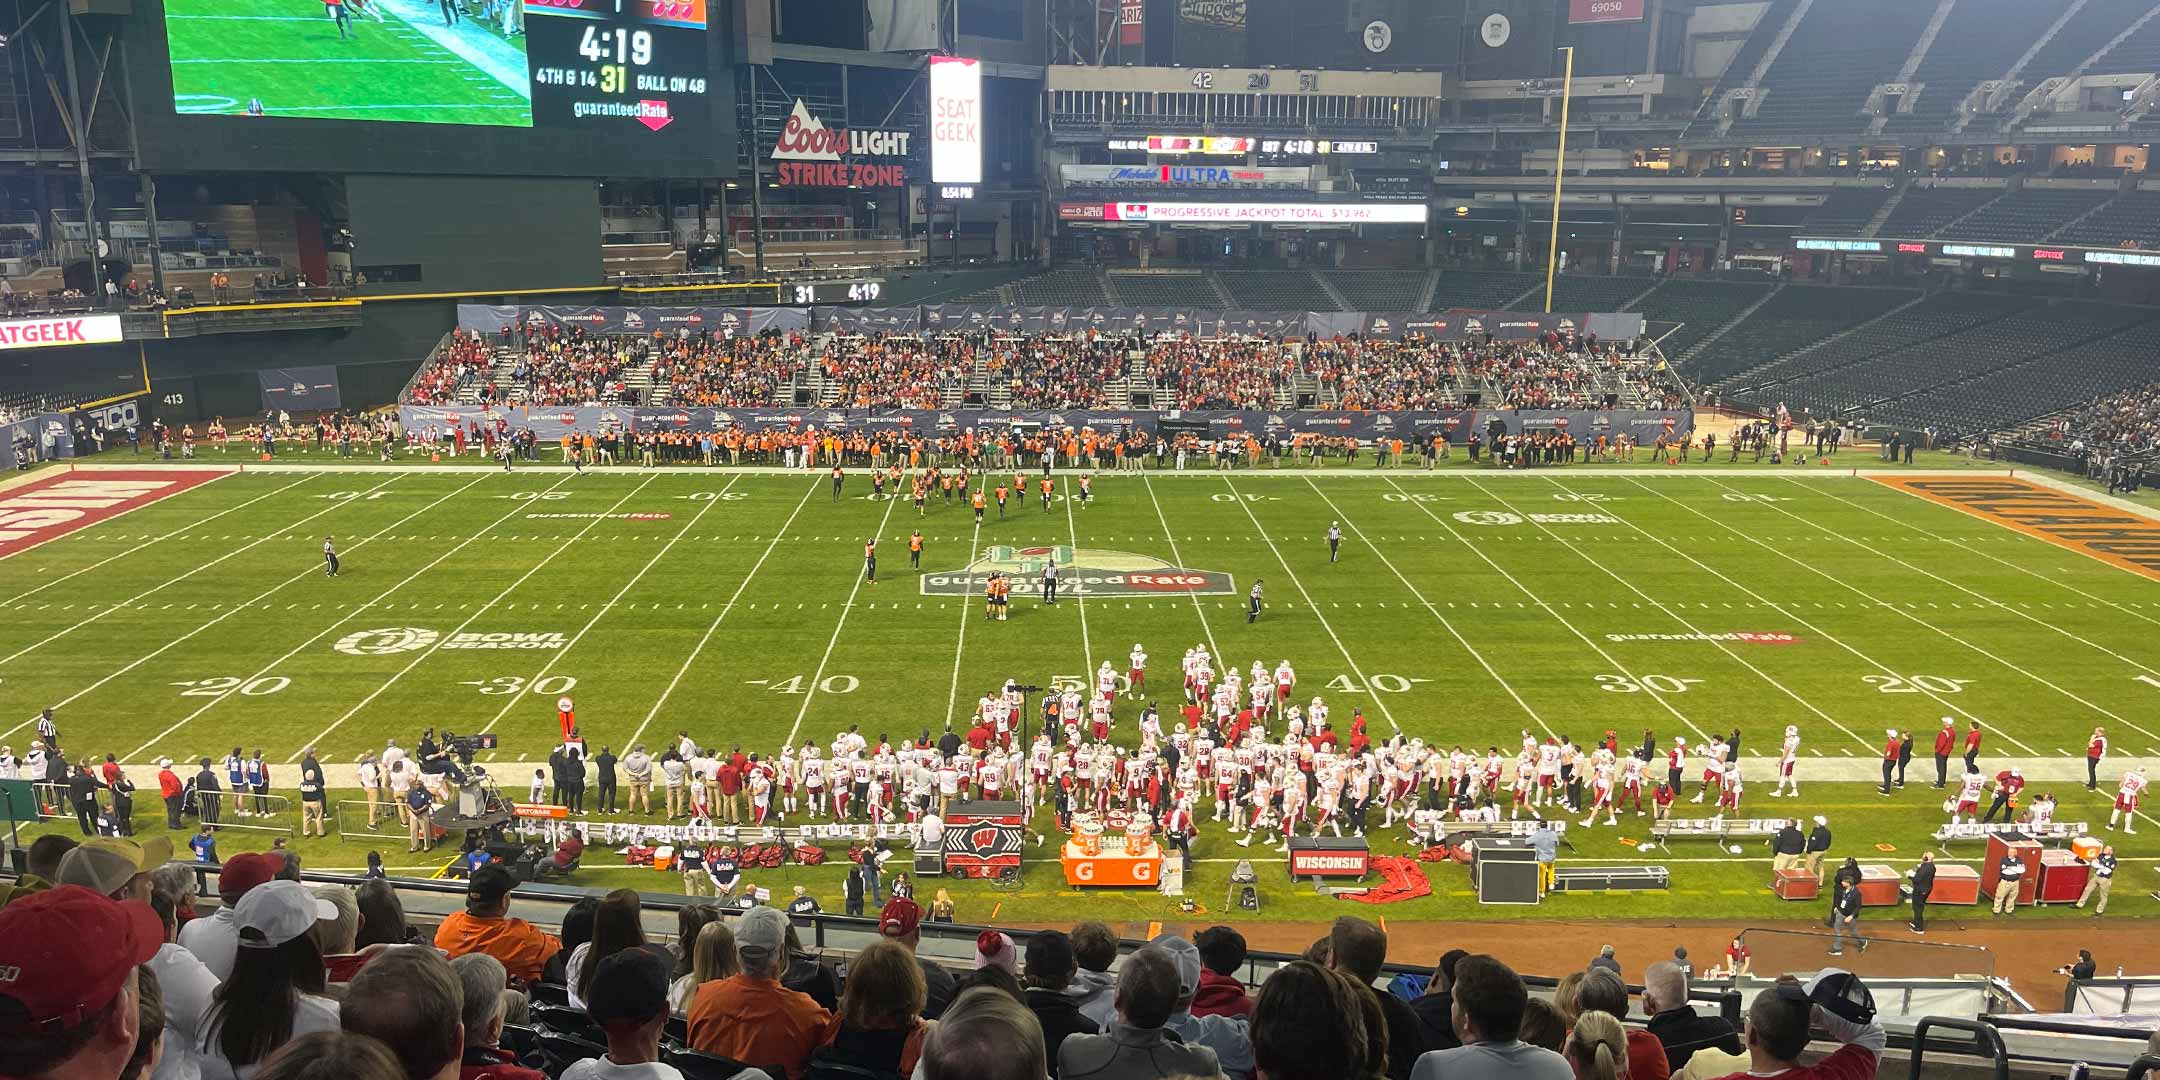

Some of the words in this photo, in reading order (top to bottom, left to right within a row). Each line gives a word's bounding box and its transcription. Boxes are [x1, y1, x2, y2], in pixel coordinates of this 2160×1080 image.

[1591, 2, 1622, 12] 69050
[579, 26, 652, 65] 4:19
[536, 68, 563, 84] 4TH
[580, 71, 596, 86] 14
[600, 64, 625, 93] 31
[637, 75, 667, 92] BALL
[670, 77, 687, 92] ON
[688, 78, 705, 93] 48
[1193, 72, 1213, 88] 42
[1248, 73, 1270, 89] 20
[1299, 74, 1319, 91] 51
[936, 97, 975, 118] SEAT
[778, 115, 849, 153] Coors
[851, 131, 909, 155] LIGHT
[935, 123, 976, 143] GEEK
[778, 163, 848, 187] STRIKE
[852, 164, 903, 187] ZONE
[1172, 167, 1230, 182] ULTRA
[1153, 207, 1231, 217] PROGRESSIVE
[1235, 208, 1286, 218] JACKPOT
[1291, 208, 1324, 218] TOTAL
[795, 286, 814, 302] 31
[848, 283, 880, 300] 4:19
[164, 394, 183, 405] 413
[440, 641, 564, 649] SEASON
[452, 632, 568, 641] BOWL
[181, 675, 291, 696] 20
[477, 675, 577, 695] 30
[767, 674, 860, 694] 40
[1325, 673, 1412, 693] 40
[1594, 674, 1688, 693] 30
[1860, 674, 1964, 693] 20
[808, 768, 818, 776] 24
[856, 768, 866, 778] 57
[2124, 778, 2138, 790] 29
[1295, 856, 1364, 870] WISCONSIN
